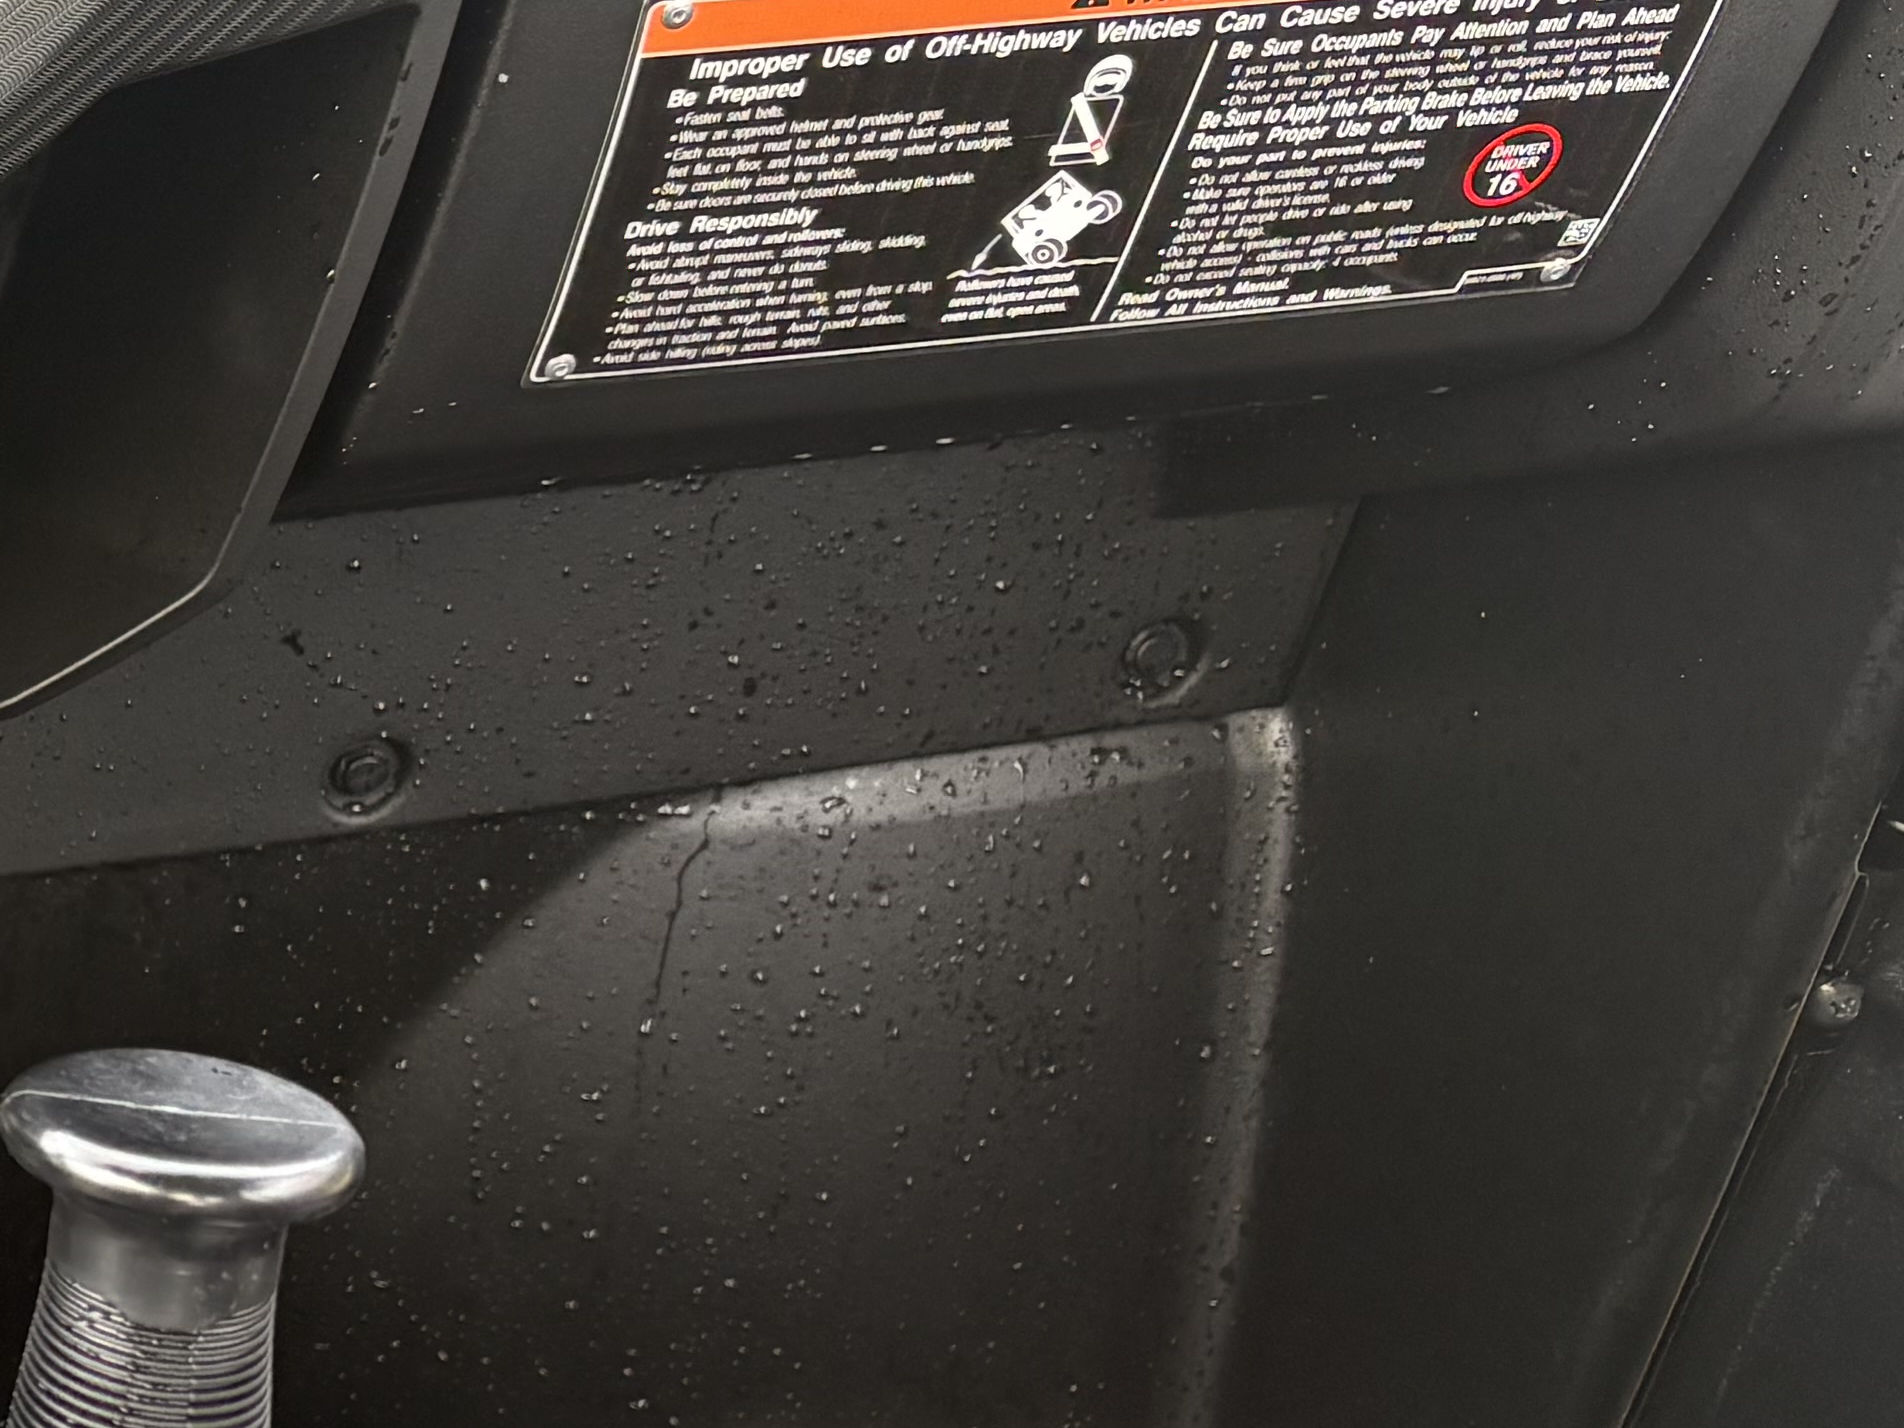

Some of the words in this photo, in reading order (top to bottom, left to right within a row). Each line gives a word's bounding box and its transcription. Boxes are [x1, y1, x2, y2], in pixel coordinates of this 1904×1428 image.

[689, 52, 810, 82] Improper
[821, 44, 872, 68] Use
[883, 38, 915, 63] of
[925, 28, 1082, 58] Off-Highway
[1097, 16, 1201, 43] Vehicles
[1214, 9, 1266, 33] Can
[1279, 4, 1360, 27] Cause
[1226, 40, 1254, 60] Be
[1260, 37, 1303, 57] Sure
[1310, 28, 1404, 53] Occupants
[1409, 24, 1445, 46] Pay
[1449, 18, 1529, 40] Attention
[1534, 12, 1572, 33] and
[1575, 10, 1616, 29] Plan
[1620, 3, 1680, 26] Ahead
[666, 88, 698, 108] Be
[706, 77, 806, 106] Prepared
[1196, 109, 1222, 130] Be
[1222, 107, 1262, 127] Sure
[1262, 105, 1282, 124] to
[1278, 100, 1330, 127] Apply
[1329, 98, 1358, 118] the
[1358, 93, 1420, 116] Parking
[1420, 89, 1468, 110] Brake
[1468, 84, 1523, 106] Before
[1522, 79, 1585, 101] Leaving
[1584, 74, 1613, 95] the
[1614, 71, 1670, 93] Vehicle.
[1187, 129, 1259, 151] Require
[1265, 122, 1329, 144] Proper
[1335, 119, 1372, 137] Use
[1378, 114, 1402, 133] of
[1408, 112, 1448, 130] Your
[1456, 105, 1519, 126] Vehicle
[1190, 155, 1213, 169] Do
[1216, 153, 1252, 169] your
[1254, 149, 1286, 165] part
[1290, 148, 1307, 160] to
[1310, 142, 1366, 160] prevent
[1484, 155, 1540, 172] UNDER
[1490, 141, 1550, 159] DRIVER
[1486, 171, 1520, 196] 16
[623, 218, 681, 239] Drive
[689, 206, 818, 234] Responsibly
[1108, 306, 1160, 321] Follow
[1163, 302, 1189, 316] All
[1192, 295, 1280, 313] Instructions
[1284, 289, 1317, 306] and
[1320, 284, 1391, 303] Warnings.
[1117, 289, 1160, 306] Read
[1164, 283, 1226, 301] Owner's
[1231, 276, 1289, 294] Manual.
